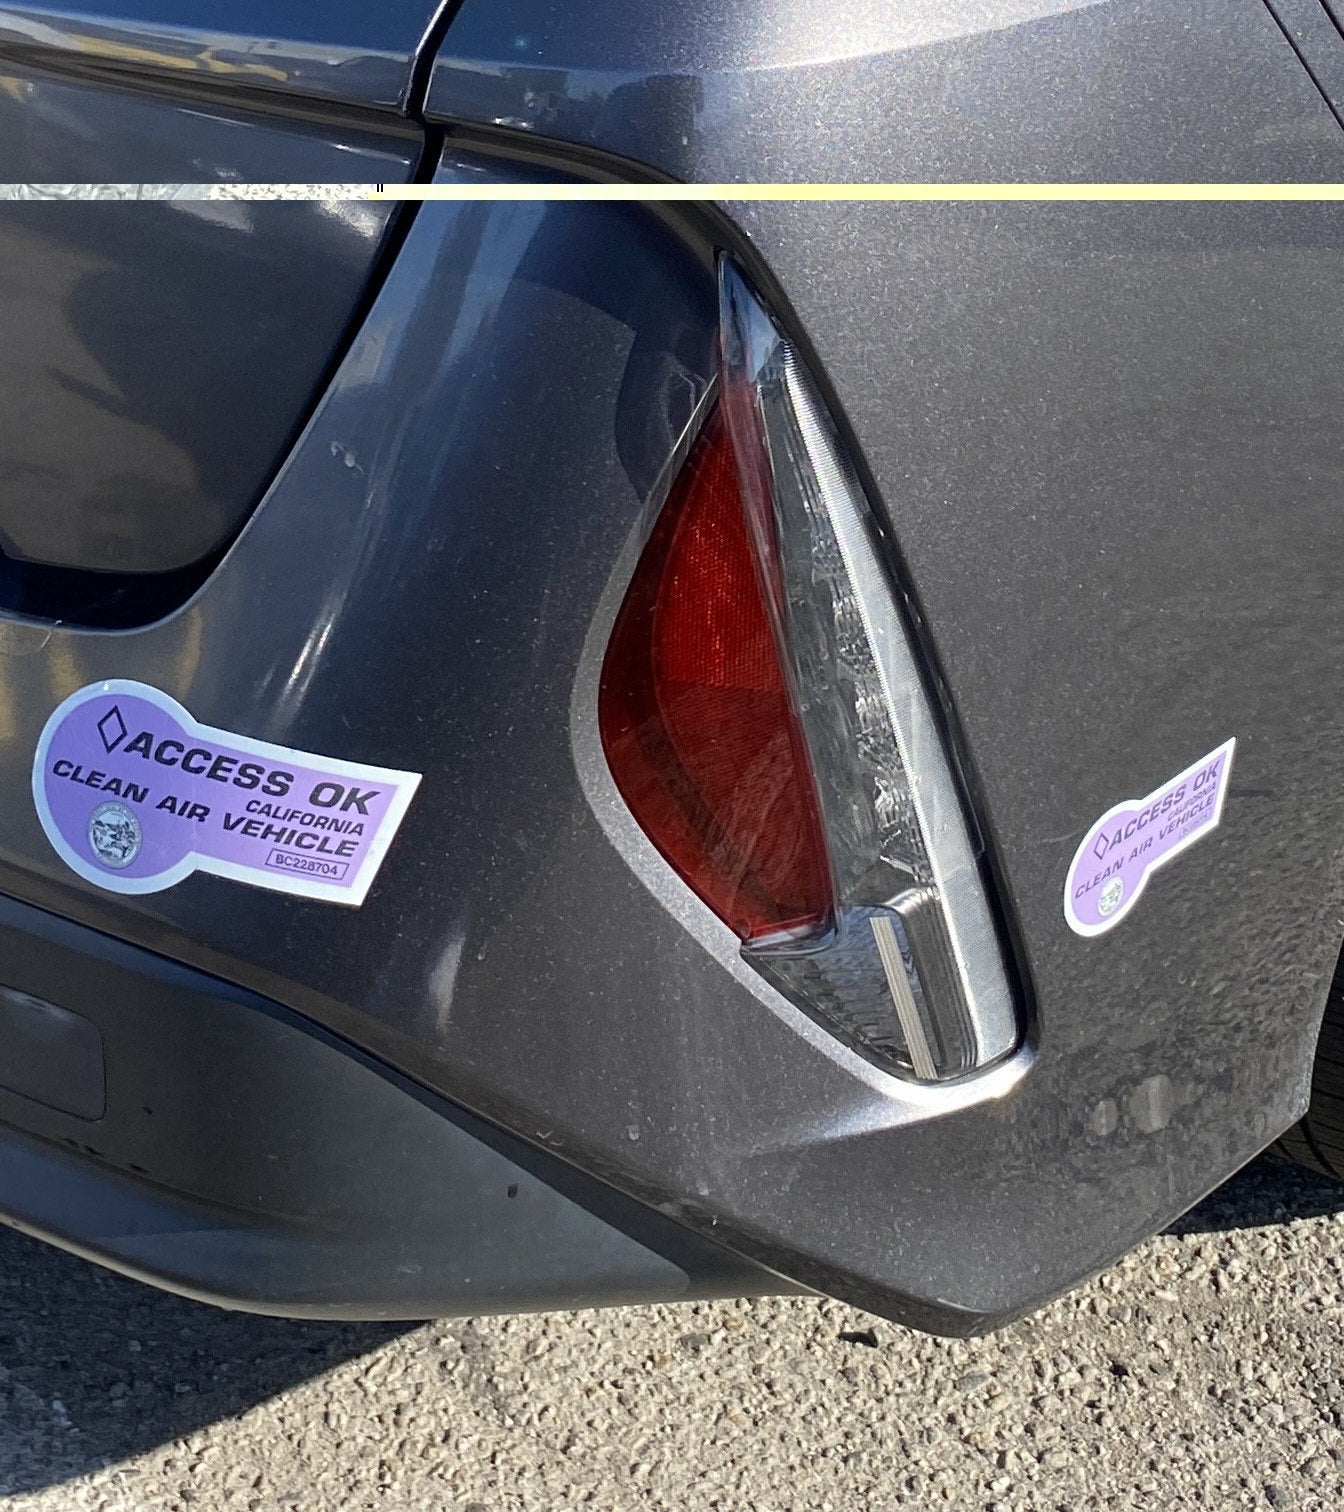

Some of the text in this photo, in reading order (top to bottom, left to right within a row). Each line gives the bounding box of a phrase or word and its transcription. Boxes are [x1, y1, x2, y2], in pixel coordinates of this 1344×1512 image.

[52, 759, 359, 857] CLEAN AIR VEHICLE
[123, 731, 381, 816] ACCESS OK
[1109, 783, 1187, 850] ACCESS
[1192, 759, 1221, 791] OK
[1167, 781, 1216, 821] CALIFORNIA
[245, 799, 364, 836] CALIFORNIA
[1074, 857, 1124, 899] CLEAN
[1128, 836, 1153, 862] AIR
[1159, 792, 1215, 840] VEHICLE
[276, 854, 338, 875] BC228704
